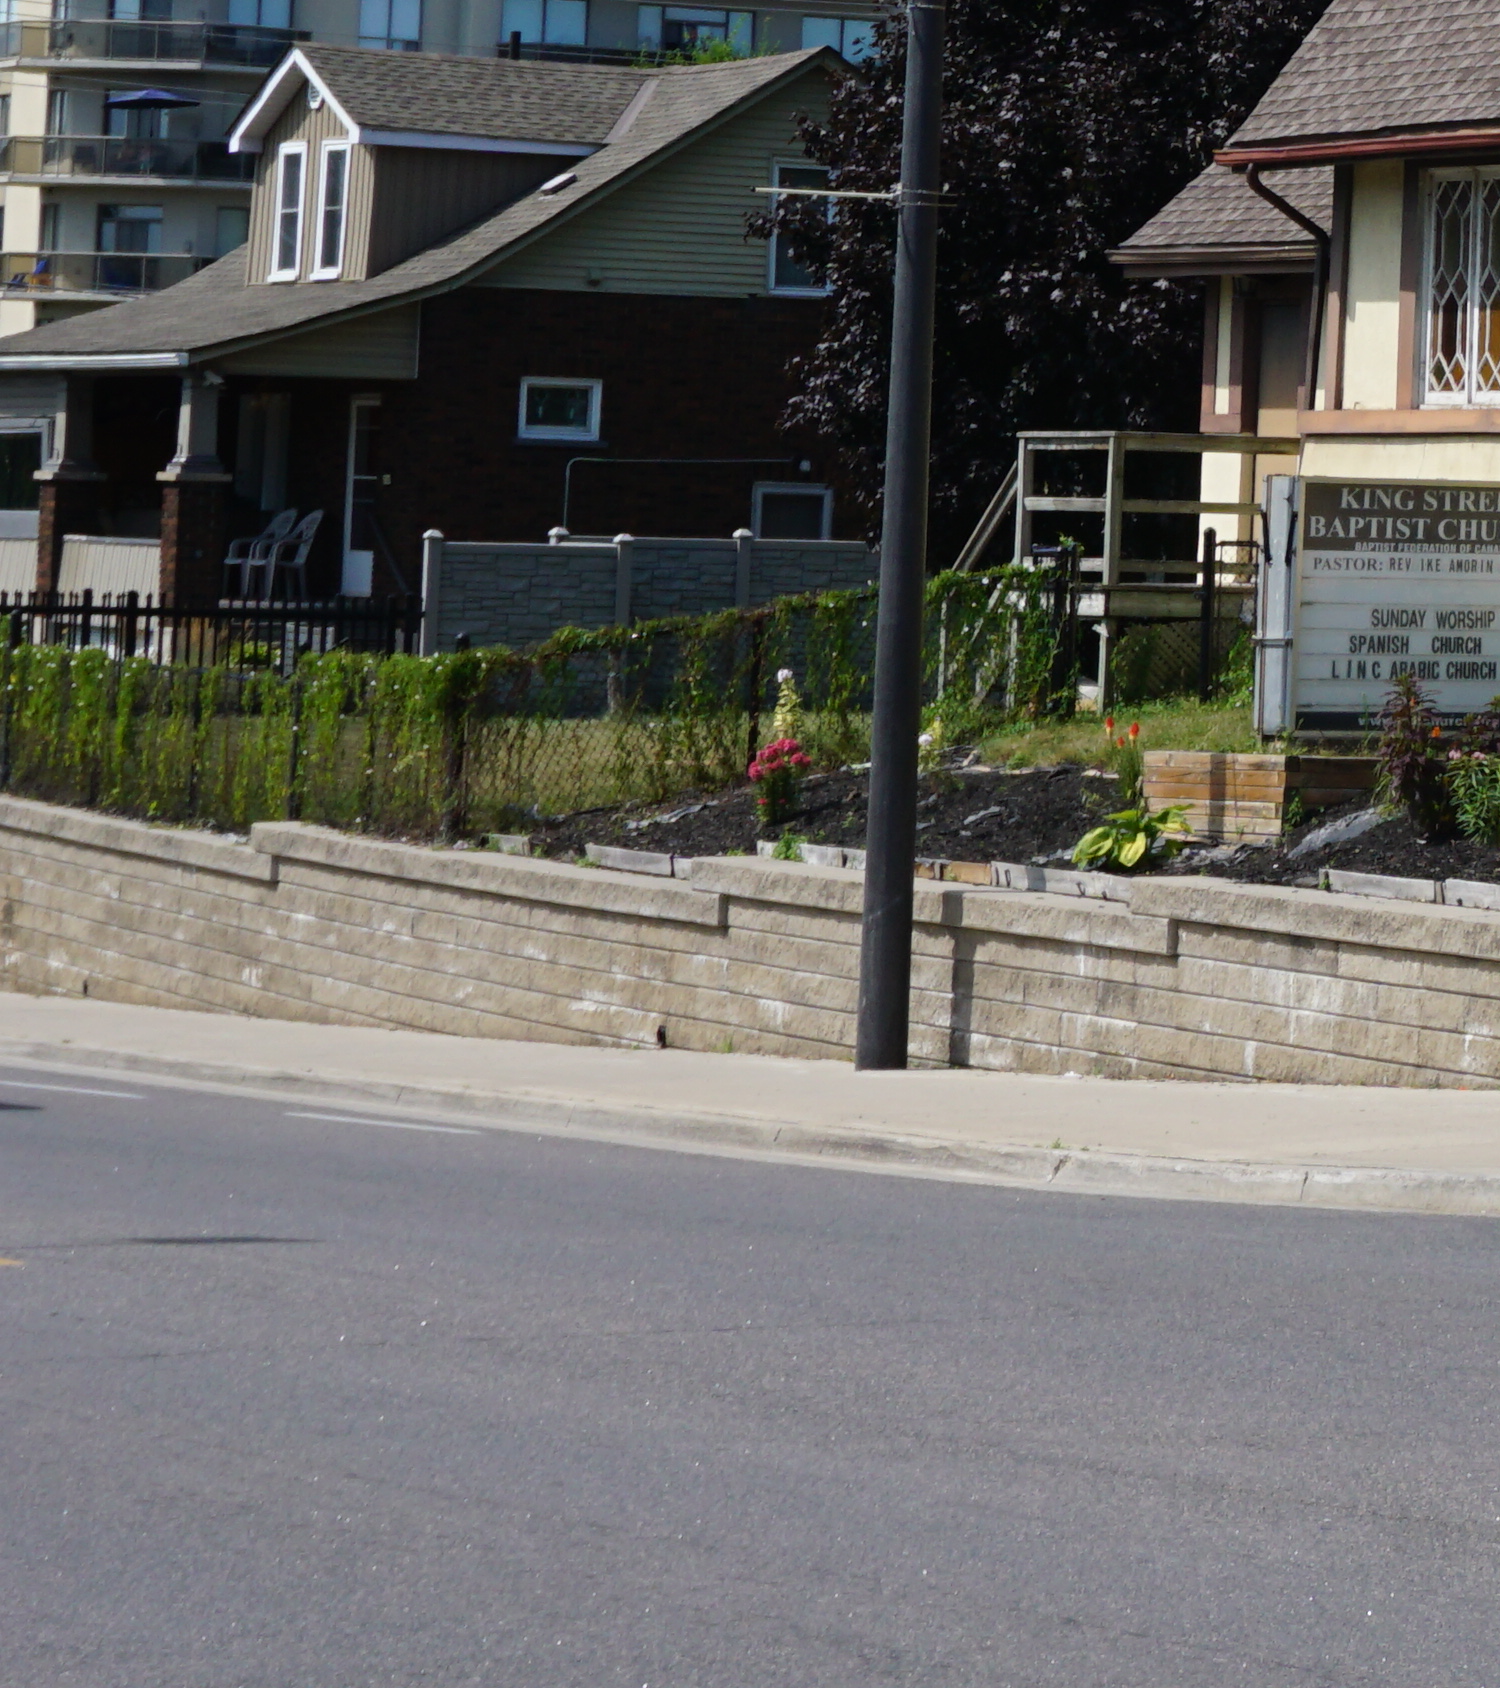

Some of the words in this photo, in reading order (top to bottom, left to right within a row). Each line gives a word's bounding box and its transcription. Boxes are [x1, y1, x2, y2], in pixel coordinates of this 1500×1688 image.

[1340, 487, 1415, 511] KING
[1309, 515, 1431, 540] BAPTIST
[1354, 541, 1396, 552] BAPTIST
[1398, 542, 1457, 553] FEDERATION
[1460, 544, 1472, 554] OF
[1313, 557, 1383, 571] PASTOR:
[1389, 557, 1412, 571] REV
[1421, 558, 1441, 572] IKE
[1449, 559, 1493, 574] AMORIN
[1371, 609, 1426, 628] SUNDAY
[1436, 610, 1495, 629] WORSHIP
[1349, 635, 1409, 653] SPANISH
[1431, 636, 1482, 654] CHURCH
[1389, 661, 1440, 680] ARABIC
[1446, 661, 1497, 680] CHURCH
